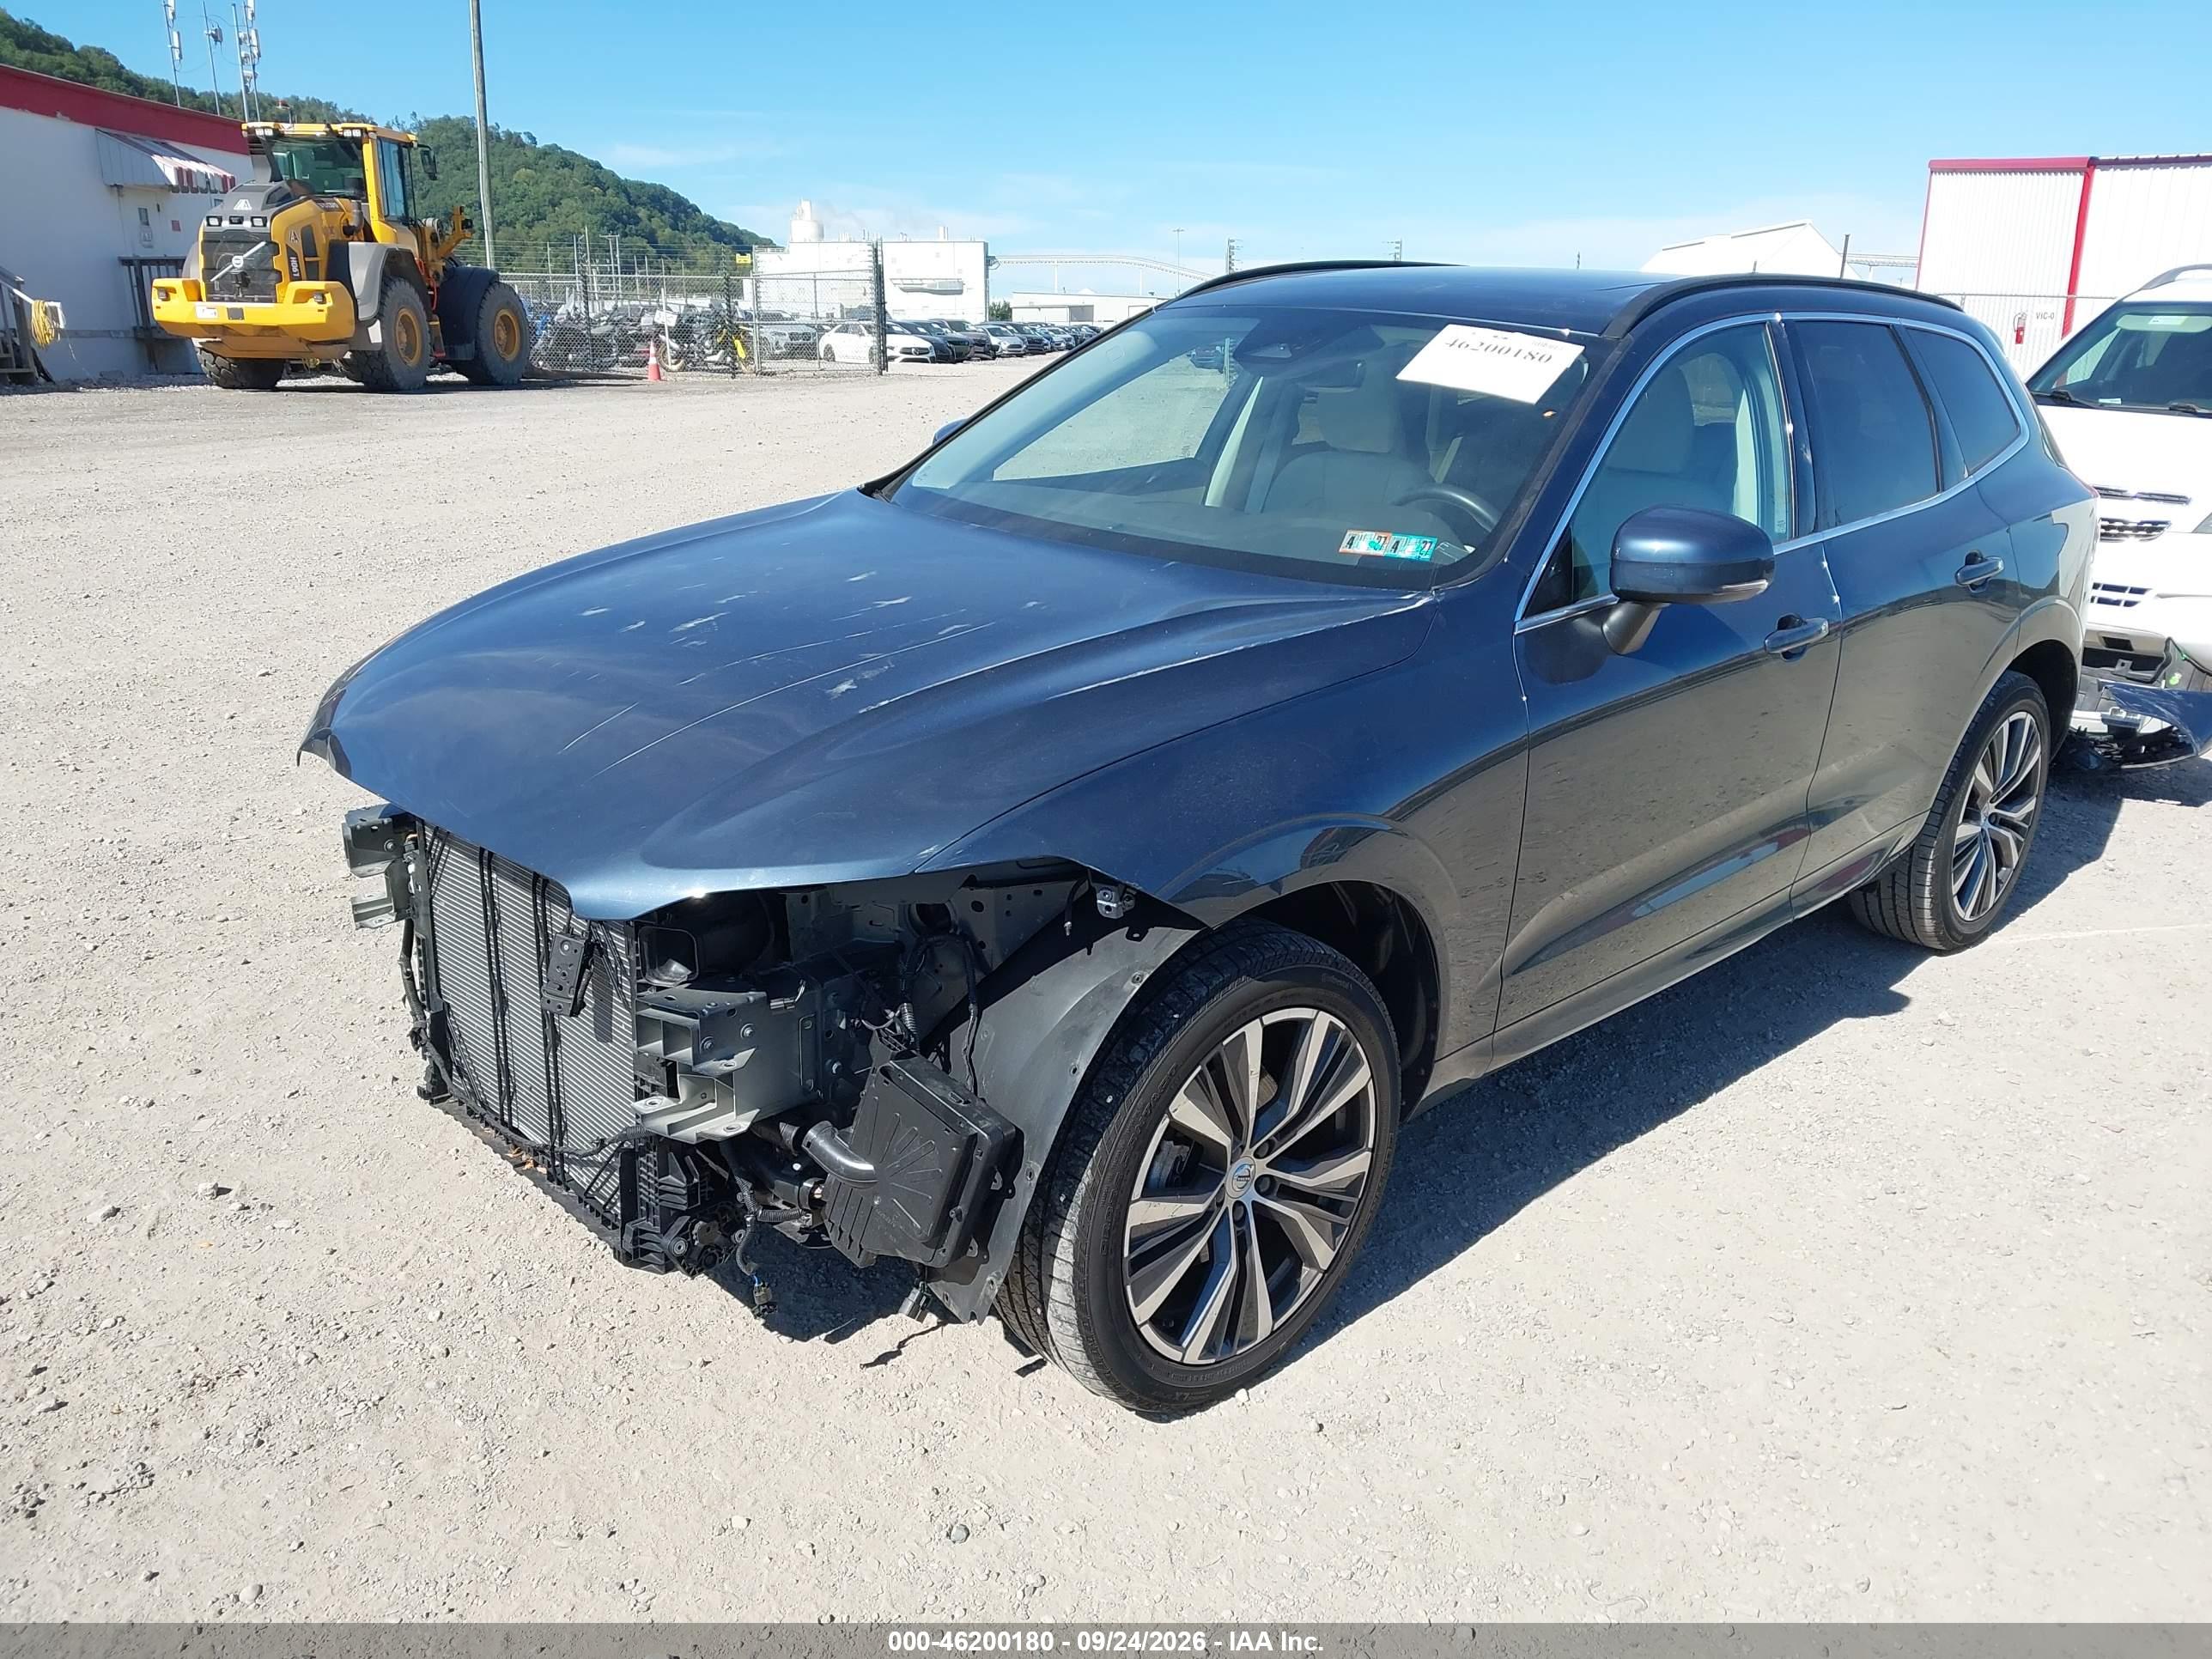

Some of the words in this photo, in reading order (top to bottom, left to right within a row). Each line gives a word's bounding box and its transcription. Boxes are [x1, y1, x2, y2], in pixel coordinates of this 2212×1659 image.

[1446, 338, 1553, 363] 46200180
[1346, 536, 1356, 550] 4
[1391, 540, 1401, 554] 4
